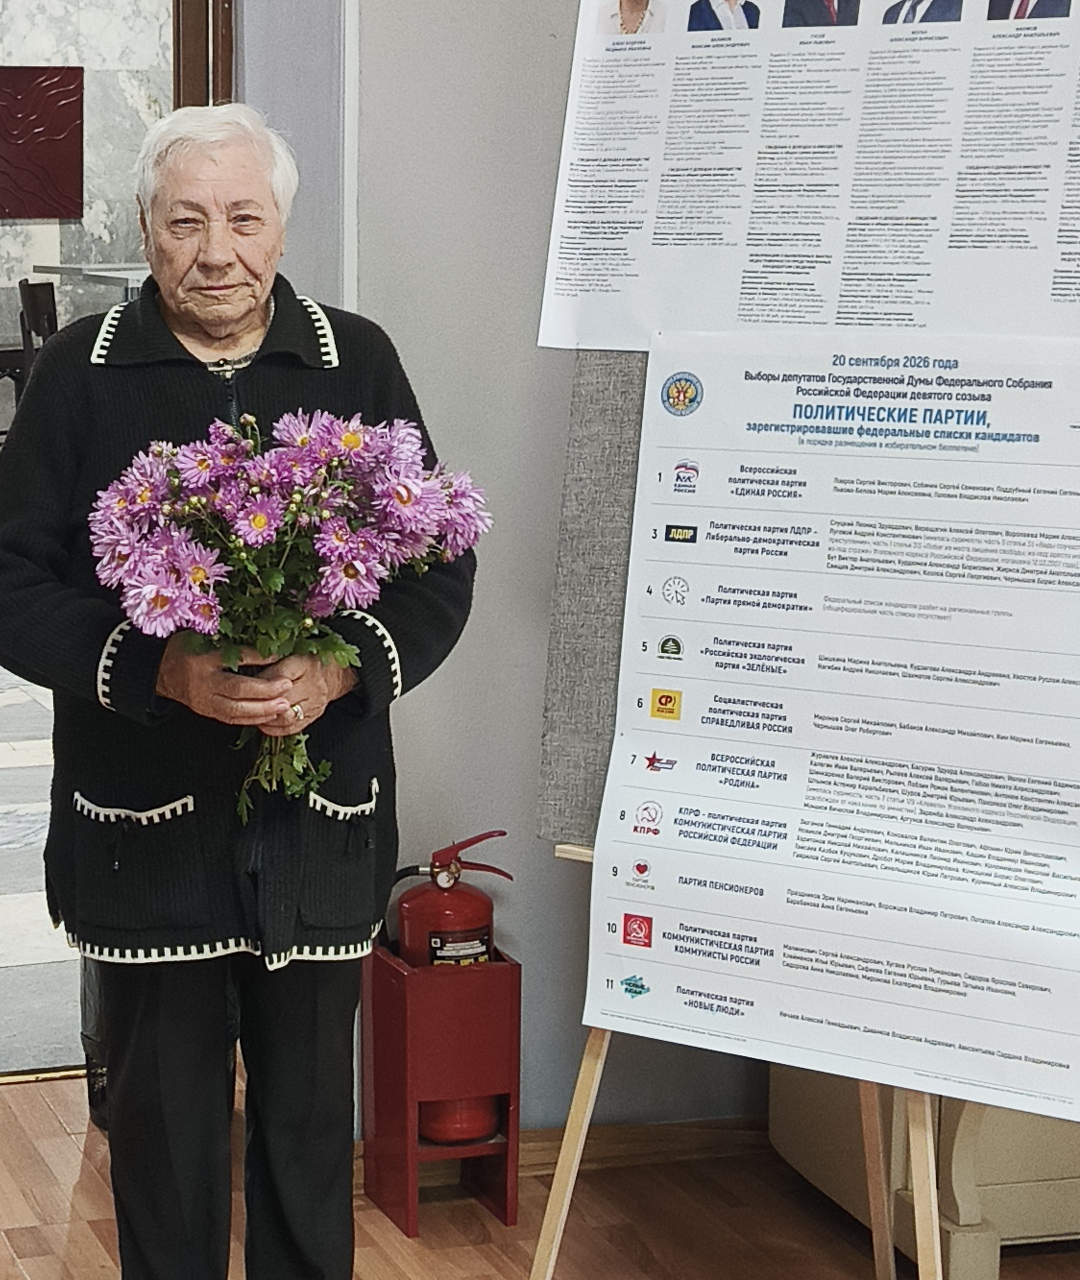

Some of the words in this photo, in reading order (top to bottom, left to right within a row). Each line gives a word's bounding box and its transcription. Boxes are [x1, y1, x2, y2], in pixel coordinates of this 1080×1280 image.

[832, 354, 846, 367] 20
[848, 355, 900, 370] сентября
[902, 355, 930, 369] 2026
[932, 358, 959, 371] года
[744, 370, 781, 383] Выборы
[781, 373, 826, 384] депутатов
[828, 373, 905, 386] Государственной
[906, 375, 934, 388] Думы
[935, 375, 1004, 389] Федерального
[1005, 377, 1053, 391] Собрания
[796, 385, 851, 398] Российской
[853, 387, 908, 401] Федерации
[909, 391, 953, 401] девятого
[955, 392, 992, 402] созыва
[793, 403, 919, 424] ПОЛИТИЧЕСКИЕ
[922, 408, 991, 428] ПАРТИИ,
[746, 422, 855, 436] зарегистрировавшие
[856, 425, 931, 439] федеральные
[933, 430, 972, 440] списки
[974, 432, 1040, 443] кандидатов
[658, 472, 662, 482] 1
[740, 464, 797, 476] Всероссийская
[728, 477, 780, 486] политическая
[781, 480, 807, 488] партия
[651, 528, 658, 540] 3
[669, 528, 694, 540] ЛДПР
[709, 520, 762, 532] Политическая
[763, 526, 789, 535] партия
[789, 526, 812, 536] ЛДПР
[705, 532, 820, 547] Либерально-демократическая
[733, 546, 759, 556] партия
[761, 547, 788, 557] России
[646, 585, 653, 596] 4
[717, 585, 770, 597] Политическая
[771, 591, 798, 600] партия
[733, 599, 761, 608] прямой
[641, 641, 648, 652] 5
[713, 636, 766, 649] Политическая
[767, 643, 793, 652] партия
[715, 661, 740, 670] партия
[749, 653, 805, 665] экологическая
[637, 697, 643, 708] 6
[713, 694, 784, 710] Социалистическая
[708, 707, 760, 719] политическая
[761, 712, 787, 722] партия
[701, 716, 761, 730] СПРАВЕДЛИВАЯ
[762, 722, 793, 734] РОССИЯ
[630, 754, 637, 765] 7
[710, 753, 776, 768] ВСЕРОССИЙСКАЯ
[696, 762, 756, 777] ПОЛИТИЧЕСКАЯ
[757, 770, 788, 782] ПАРТИЯ
[619, 810, 626, 821] 8
[678, 807, 701, 817] КПРФ
[707, 812, 760, 825] политическая
[760, 819, 787, 829] партия
[633, 825, 660, 835] КПРФ
[673, 818, 756, 836] КОММУНИСТИЧЕСКАЯ
[757, 829, 788, 840] ПАРТИЯ
[678, 829, 729, 844] РОССИЙСКОЙ
[730, 836, 778, 850] ФЕДЕРАЦИИ
[612, 866, 618, 877] 9
[678, 876, 708, 888] ПАРТИЯ
[709, 880, 764, 897] ПЕНСИОНЕРОВ
[607, 922, 617, 934] 10
[679, 922, 731, 939] Политическая
[732, 933, 758, 943] партия
[662, 931, 743, 952] КОММУНИСТИЧЕСКАЯ
[744, 945, 774, 957] ПАРТИЯ
[674, 945, 729, 961] КОММУНИСТЫ
[730, 954, 761, 966] РОССИИ
[606, 978, 614, 989] 11
[676, 985, 728, 1002] Политическая
[729, 996, 755, 1007] партия
